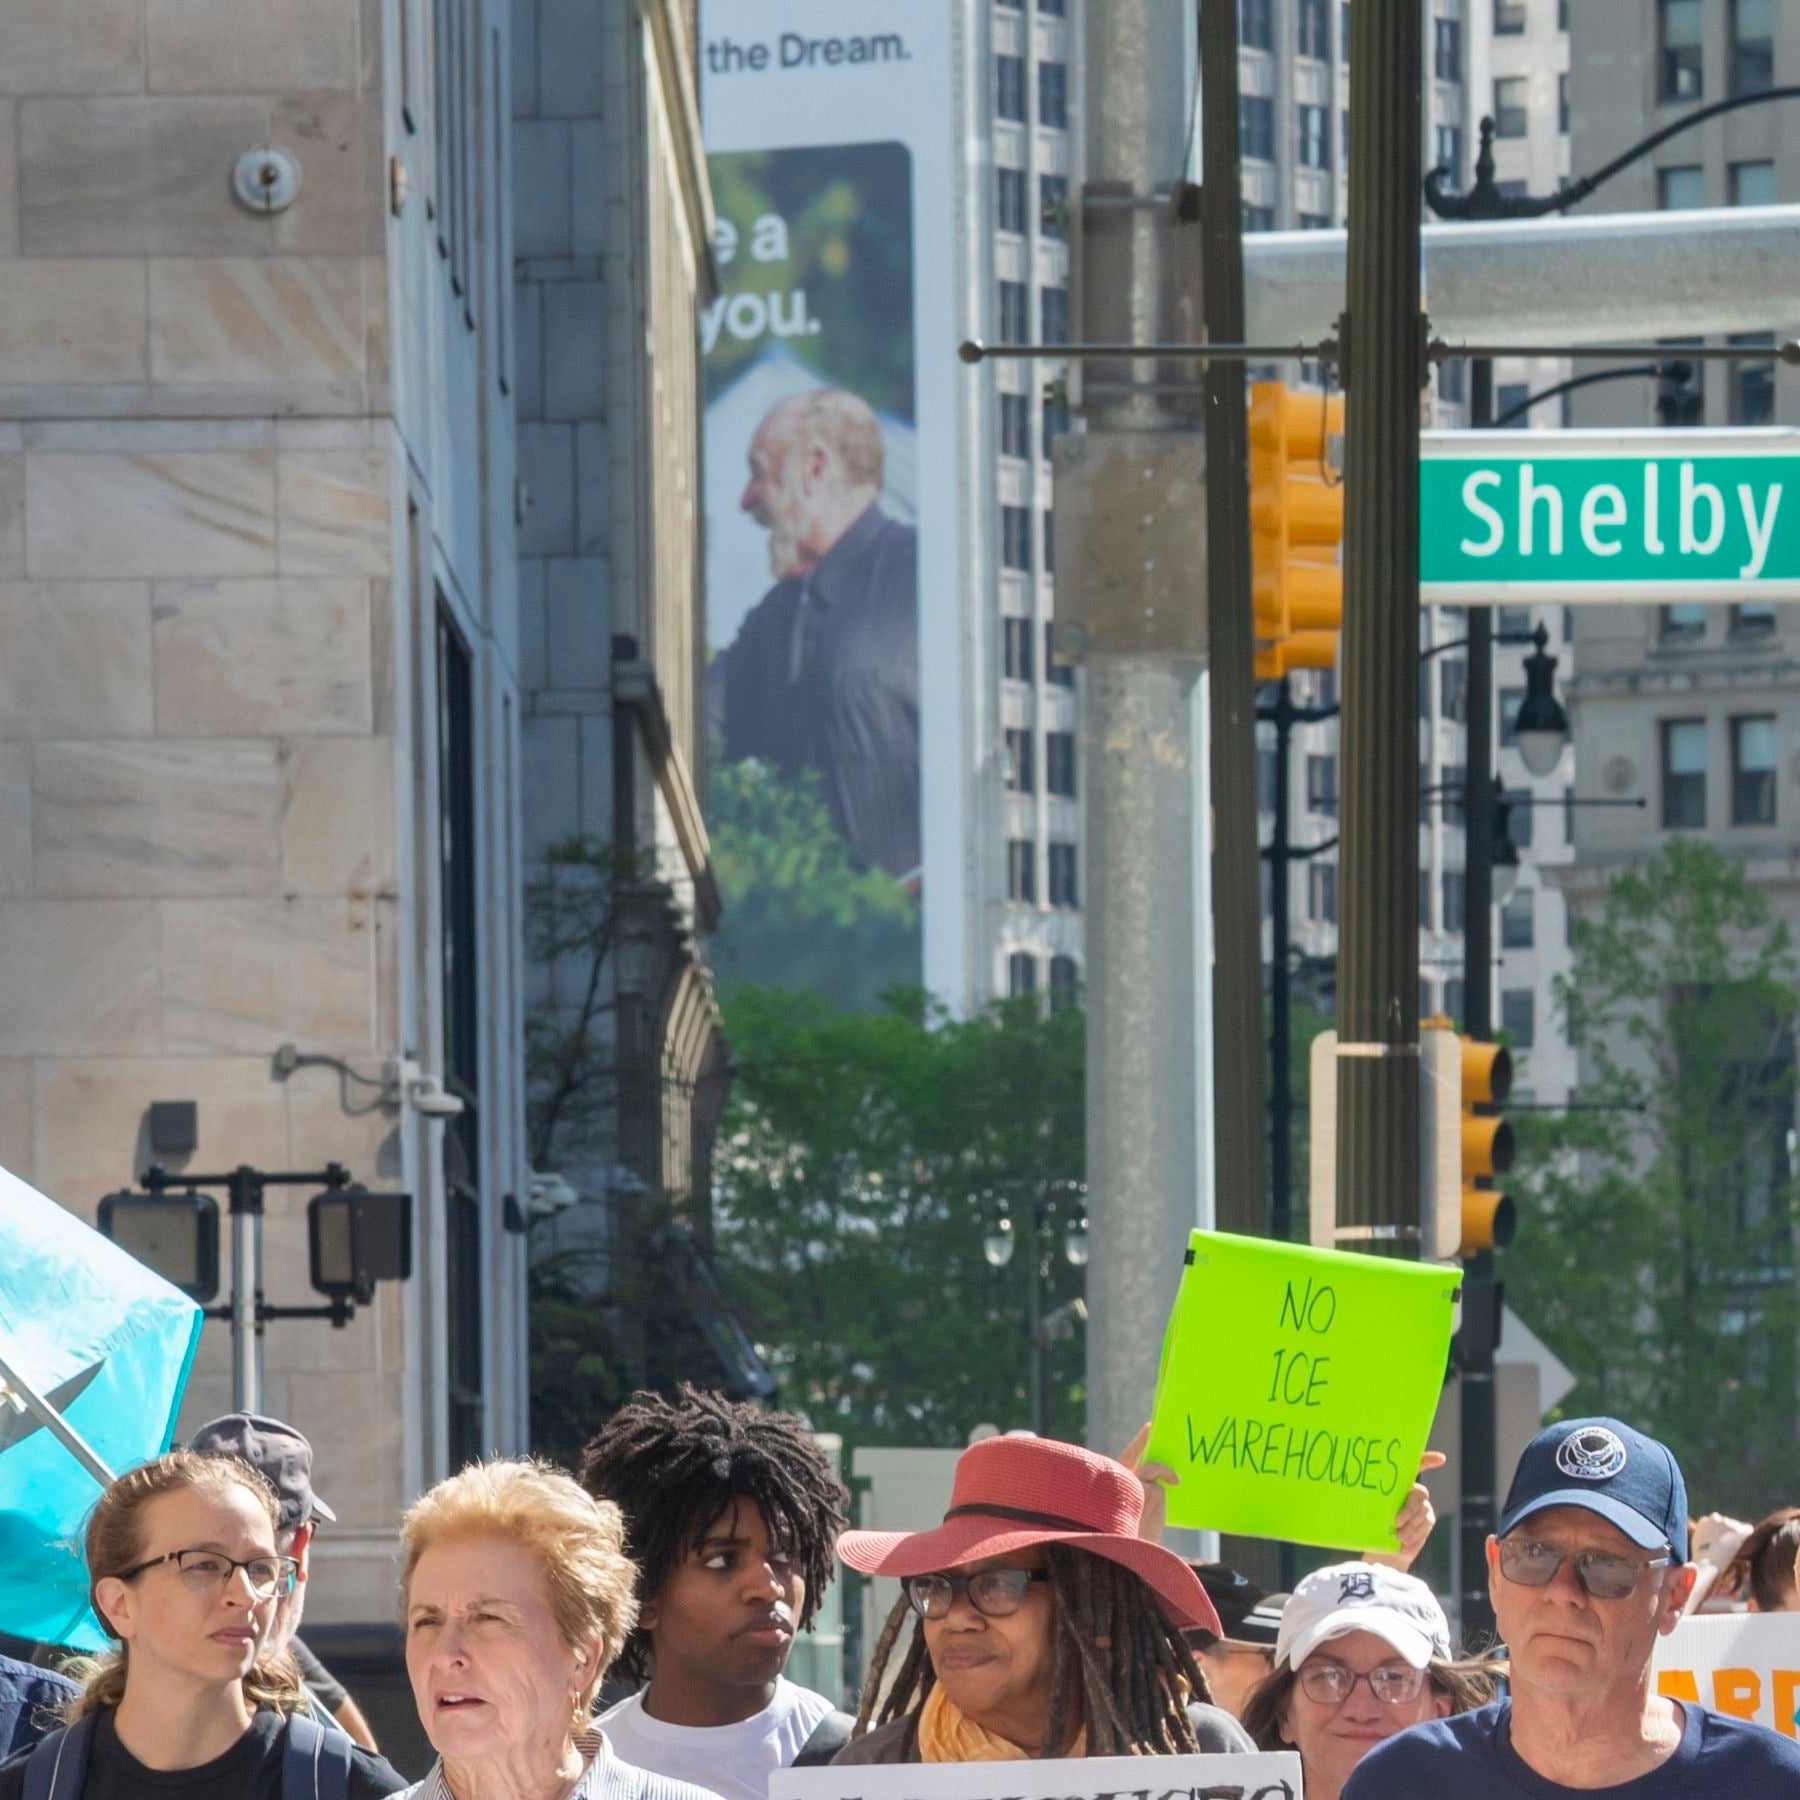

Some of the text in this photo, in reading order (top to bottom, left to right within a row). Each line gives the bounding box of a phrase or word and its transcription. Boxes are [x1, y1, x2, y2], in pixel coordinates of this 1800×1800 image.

[707, 32, 913, 74] the Dream.
[750, 212, 790, 262] a
[700, 288, 822, 355] you.
[1459, 461, 1783, 579] Shelby
[1279, 1275, 1336, 1334] NO
[1267, 1348, 1331, 1407] ICE
[1186, 1413, 1402, 1496] WAREHOUSES
